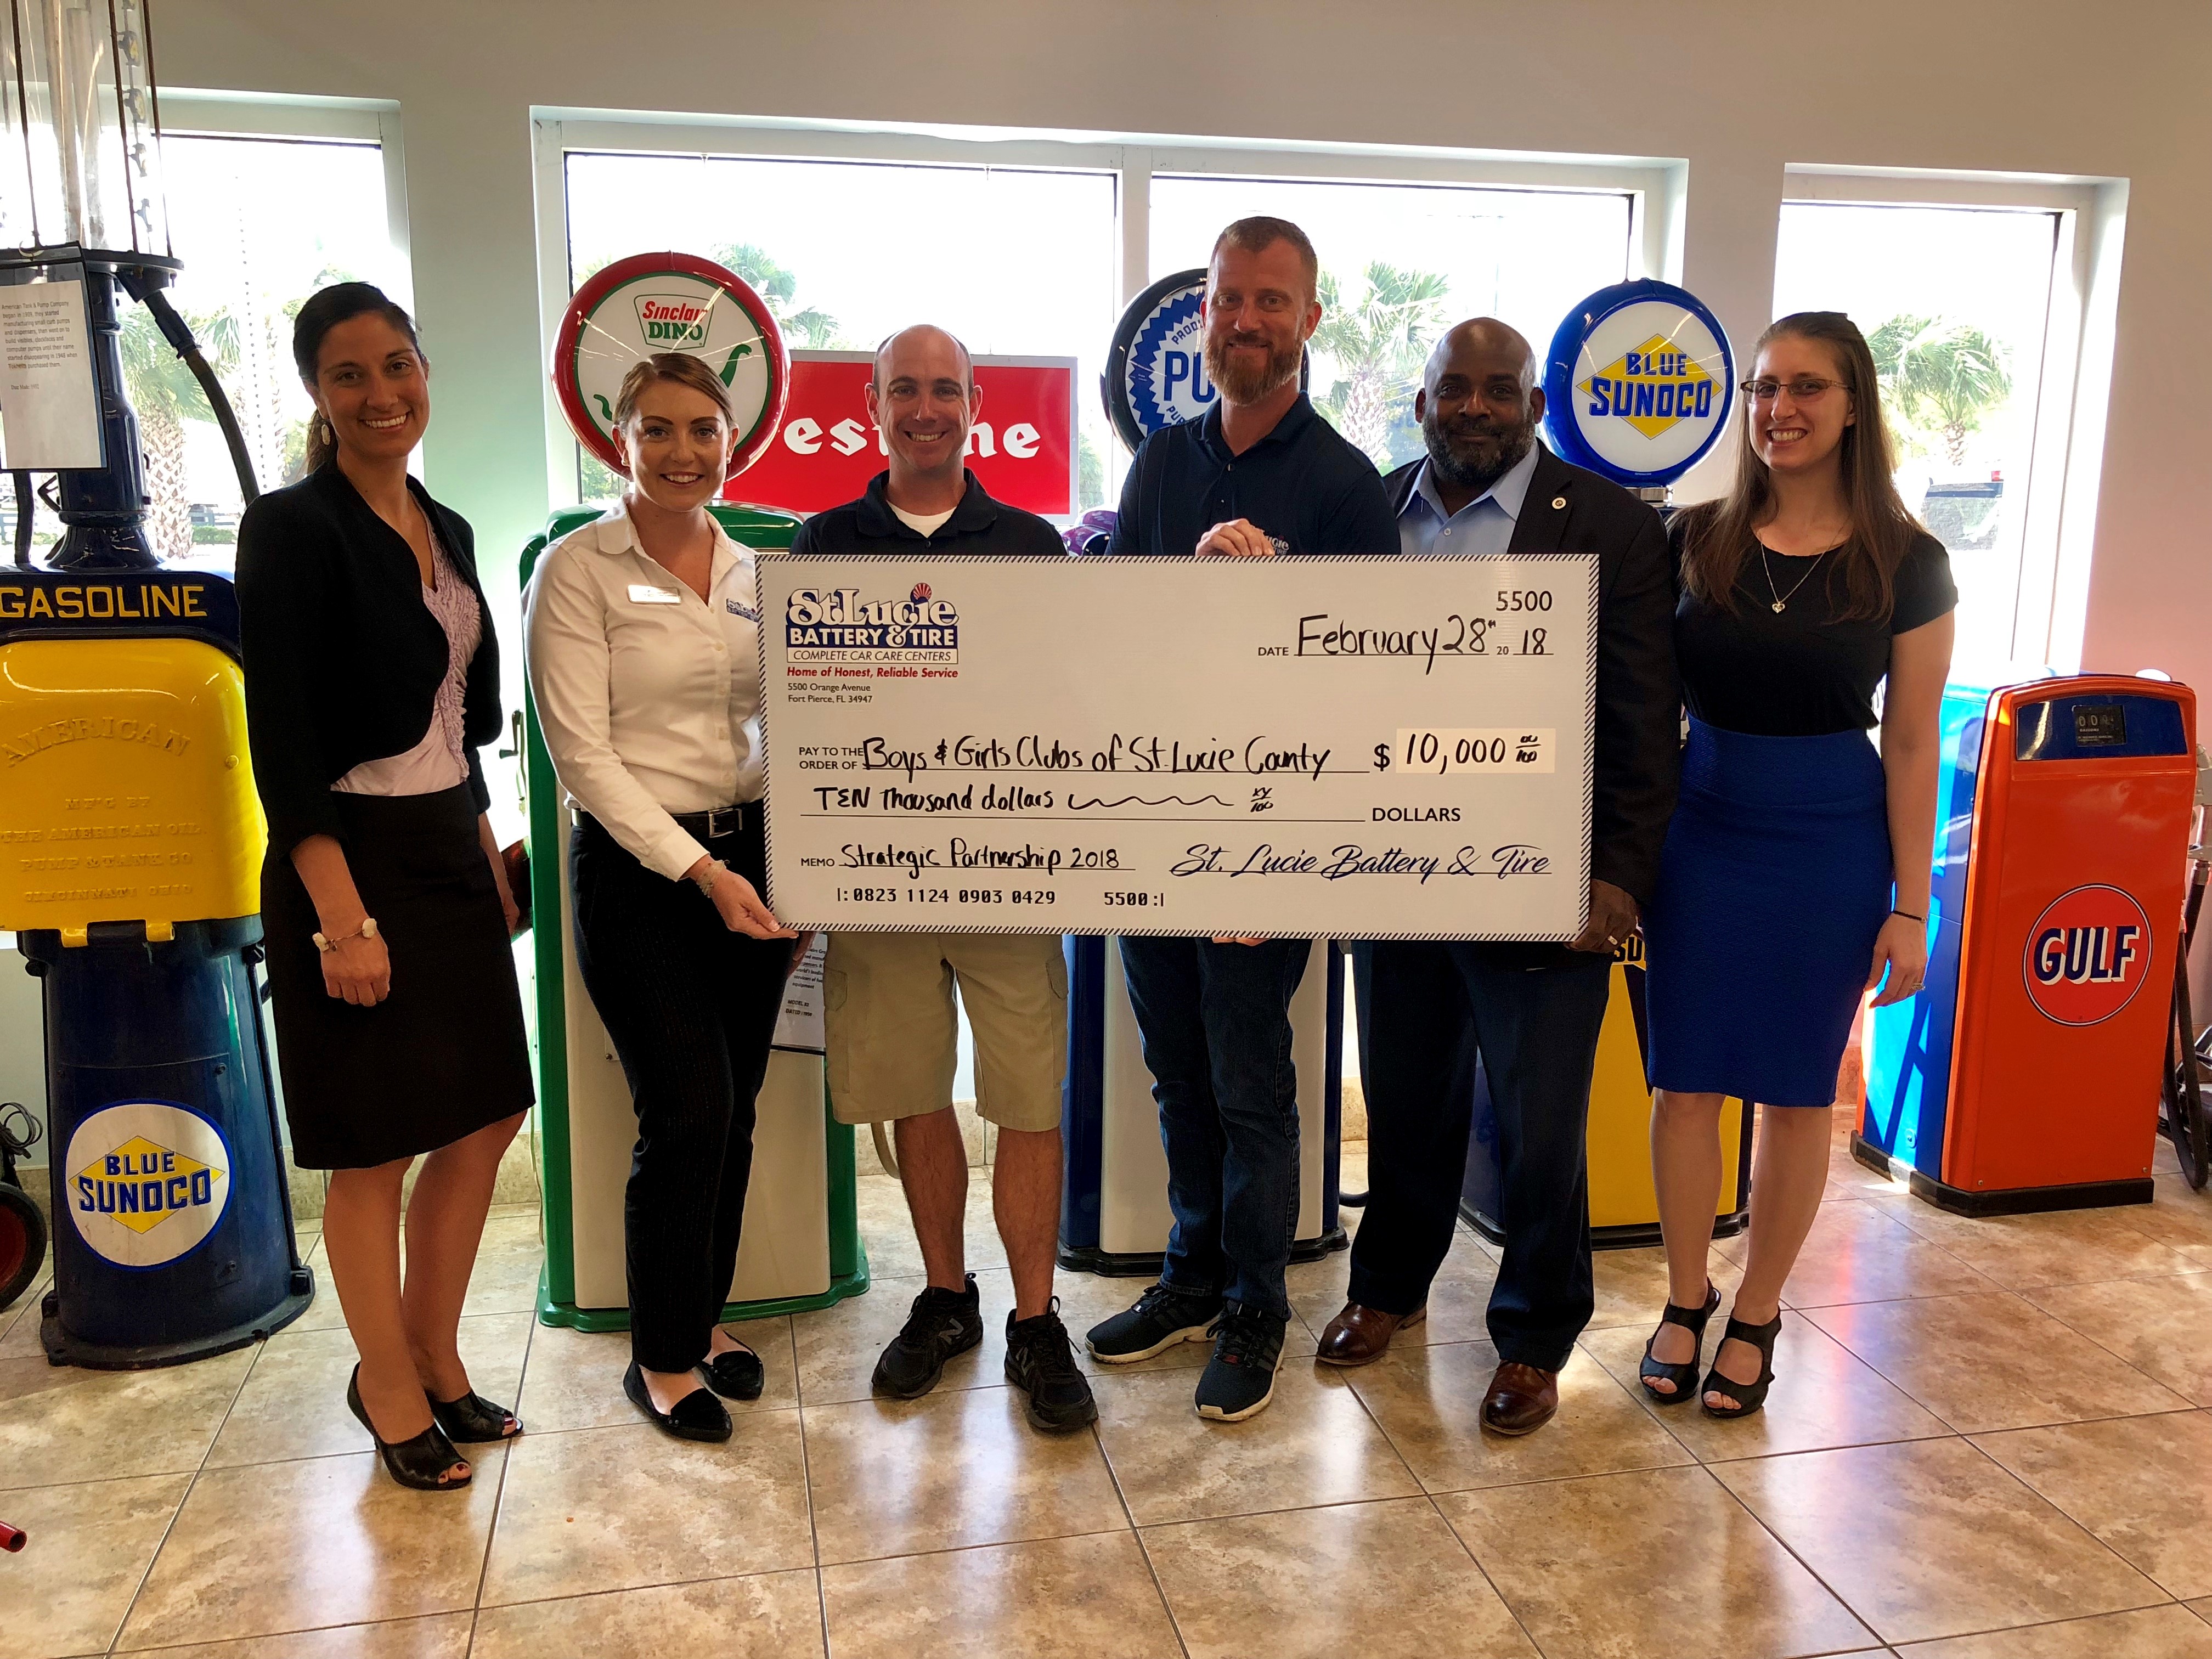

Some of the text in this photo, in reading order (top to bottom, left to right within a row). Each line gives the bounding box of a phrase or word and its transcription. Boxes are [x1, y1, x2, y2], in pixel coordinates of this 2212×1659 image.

[648, 321, 703, 341] DINO
[1626, 352, 1688, 377] BLUE
[1589, 377, 1712, 417] SUNOCO
[0, 585, 207, 618] GASOLINE
[1496, 591, 1552, 612] 5500
[790, 624, 955, 648] BATTERY & TIRE
[1258, 646, 1289, 656] DATE
[1298, 614, 1438, 675] February
[1497, 646, 1509, 655] 20
[1522, 628, 1547, 654] 18
[793, 650, 951, 662] COMPLETE CAR CARE CENTERS
[787, 667, 958, 679] Home of Honest, Reliable Service
[788, 683, 871, 693] 5500 Orange Avenue
[788, 695, 872, 704] Fort Pierce, FL 34947
[1, 716, 191, 768] AMERICAN
[799, 747, 821, 757] PAY
[823, 747, 838, 757] TO
[840, 747, 864, 757] THE
[863, 737, 927, 783] Boys
[954, 735, 1011, 768] Girls
[1017, 735, 1083, 769] Clubs
[1092, 733, 1124, 771] of
[1245, 736, 1331, 781] County
[1373, 743, 1391, 772] $
[1407, 733, 1506, 775] 10,000
[799, 760, 857, 770] ORDER OF
[813, 786, 871, 811] TEN
[981, 783, 1054, 812] dollars
[1372, 808, 1461, 822] DOLLARS
[48, 824, 161, 841] AMERICAN
[801, 838, 1551, 885] MEMO Strategic Partnership 2018 St. Lucie Battery & Tire
[907, 889, 950, 904] 1124
[959, 889, 1003, 904] 0903
[1012, 890, 1056, 905] 0429
[2033, 925, 2140, 985] GULF
[105, 1151, 175, 1176] BLUE
[78, 1168, 212, 1214] SUNOCO
